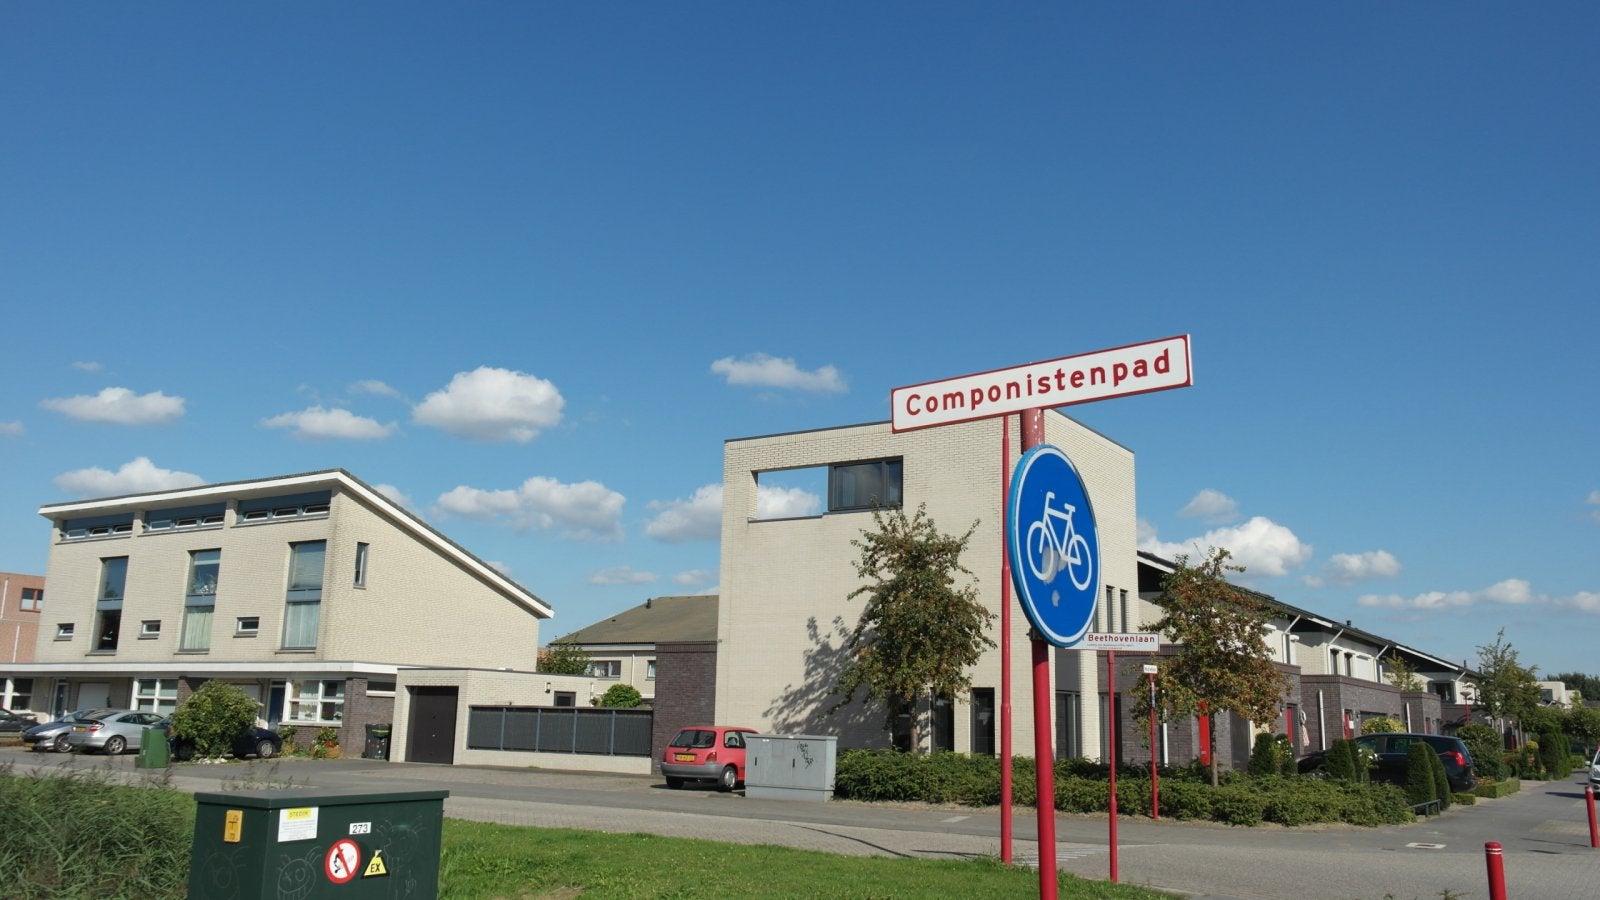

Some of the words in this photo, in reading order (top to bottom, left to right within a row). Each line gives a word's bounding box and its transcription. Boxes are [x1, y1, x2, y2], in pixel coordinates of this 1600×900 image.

[906, 347, 1170, 416] Componistenpad
[1088, 634, 1155, 643] Beethovenlaan
[352, 824, 368, 834] 273
[370, 863, 381, 873] EX
